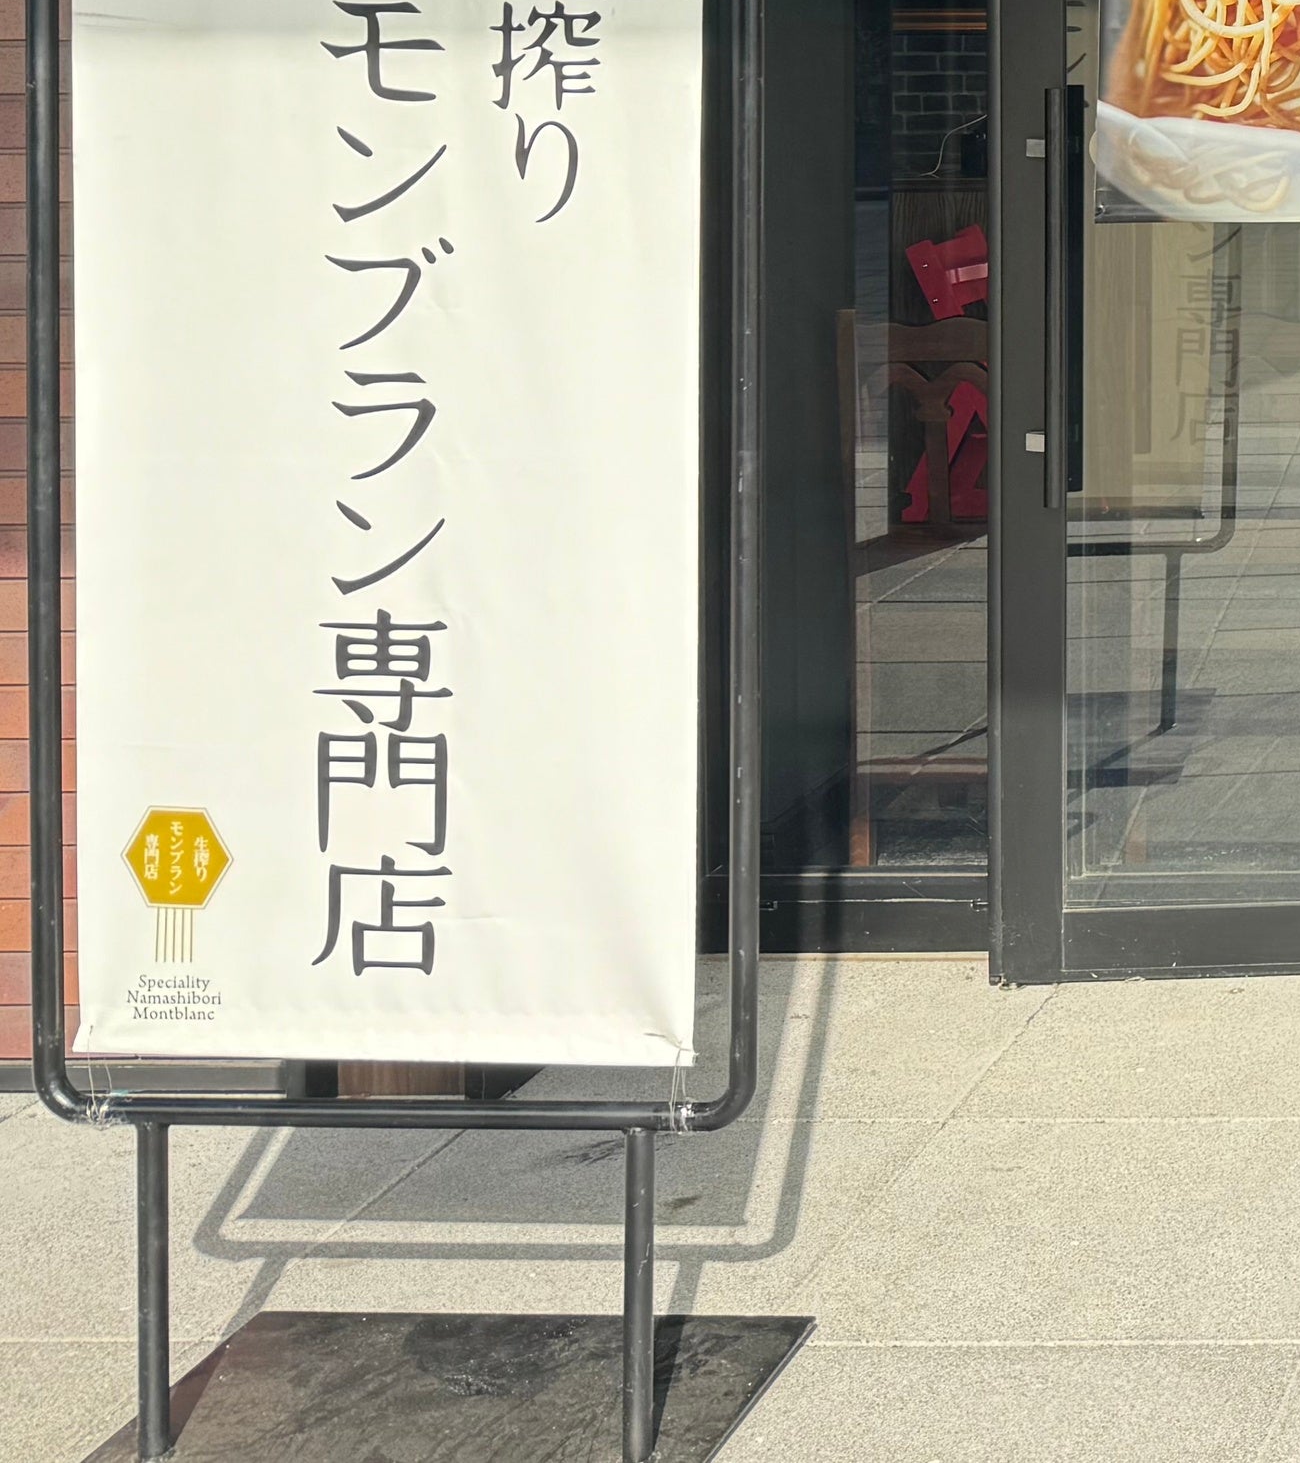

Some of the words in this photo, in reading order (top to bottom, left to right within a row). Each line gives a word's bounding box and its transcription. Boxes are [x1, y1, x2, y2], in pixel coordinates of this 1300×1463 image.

[311, 0, 455, 977] モンブラン専門店
[144, 833, 160, 880] 専門店
[169, 821, 185, 895] モンブラン
[193, 836, 210, 882] 生搾り
[126, 987, 221, 1005] Namashibori
[138, 974, 210, 994] Speciality
[133, 1006, 215, 1021] Montblanc
